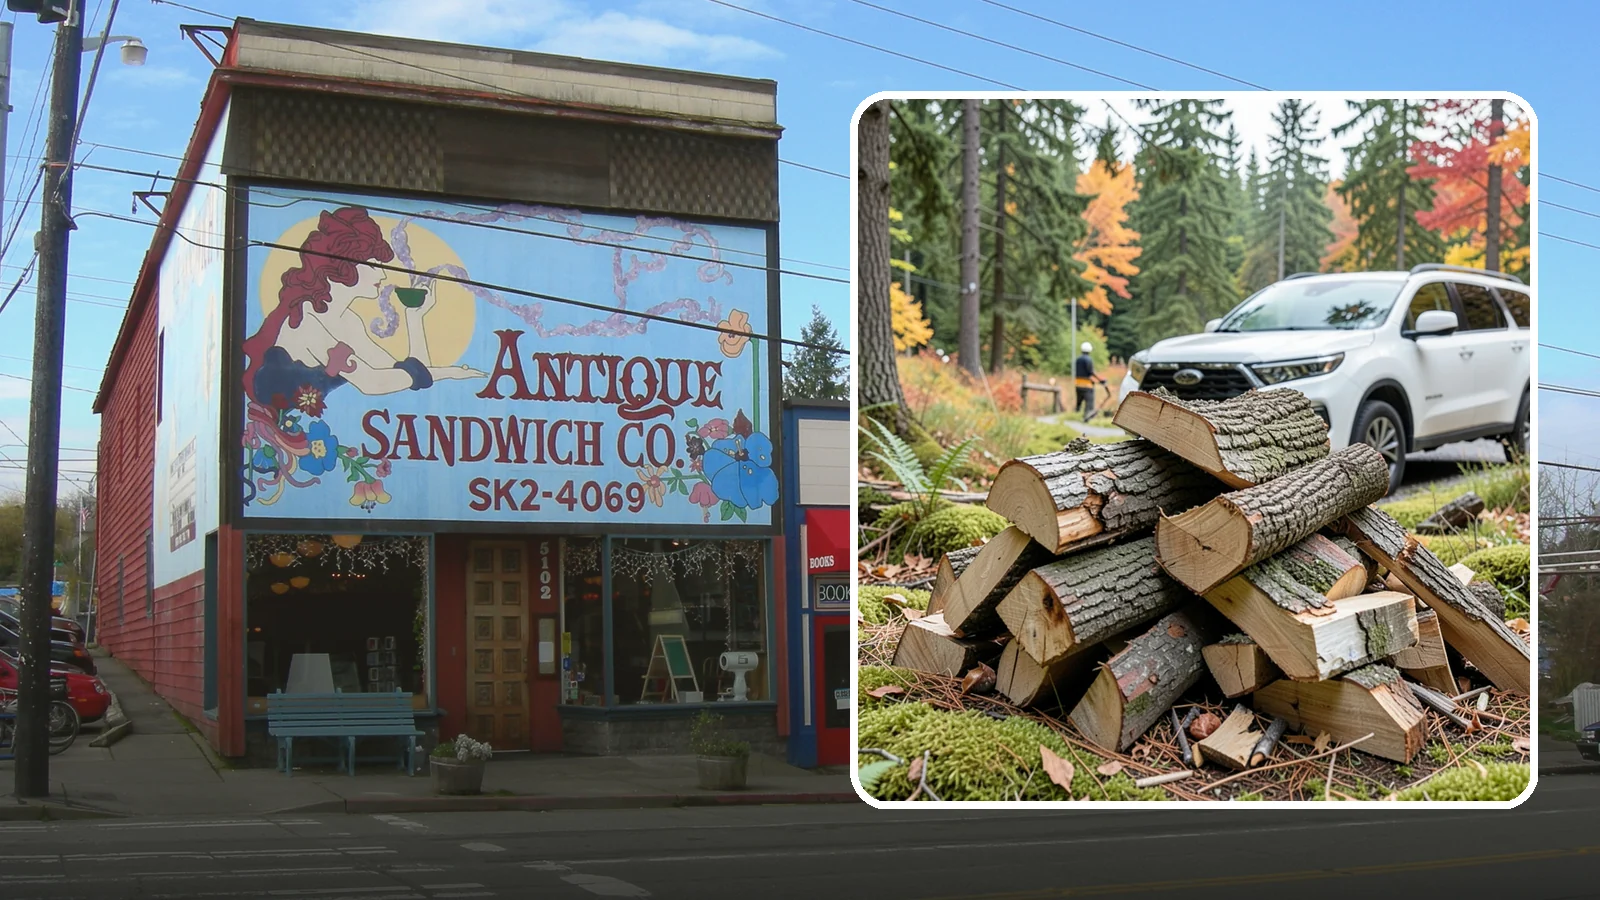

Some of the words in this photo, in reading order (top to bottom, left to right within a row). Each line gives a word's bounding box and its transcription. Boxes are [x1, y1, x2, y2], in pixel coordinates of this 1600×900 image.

[361, 408, 605, 467] SANDWICH
[617, 421, 684, 469] CO.
[468, 477, 645, 513] SK2-4069
[539, 541, 552, 600] 5102
[809, 554, 835, 569] BOOKS
